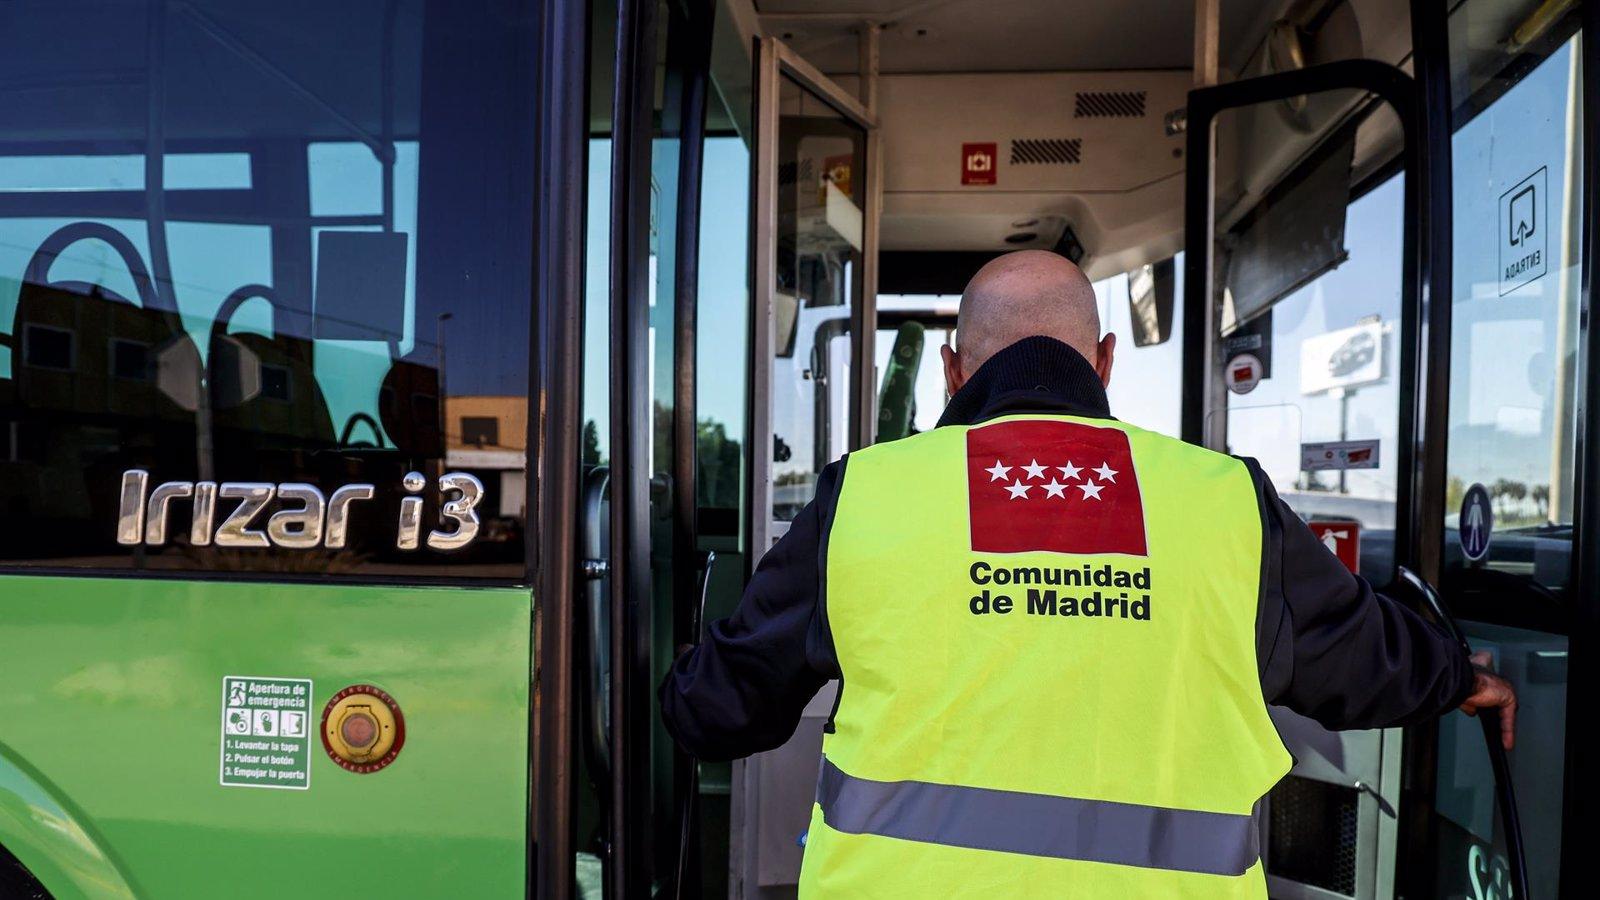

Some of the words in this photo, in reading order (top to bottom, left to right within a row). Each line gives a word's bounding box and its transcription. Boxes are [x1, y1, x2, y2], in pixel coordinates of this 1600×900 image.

[117, 469, 375, 549] Irizar
[397, 471, 484, 550] i3
[969, 561, 1151, 590] Comunidad
[969, 590, 1014, 615] de
[1027, 588, 1151, 621] Madrid
[248, 682, 290, 694] Apertura
[293, 685, 305, 695] de
[248, 695, 305, 708] emergencia
[327, 686, 398, 710] EMERGENCIA
[226, 741, 234, 749] 1.
[235, 741, 270, 750] Levantar
[271, 742, 279, 750] la
[280, 743, 299, 752] tapa
[225, 754, 233, 762] 2.
[234, 754, 260, 763] Pulsar
[261, 755, 269, 764] el
[270, 756, 294, 765] botón
[328, 751, 398, 773] EMERGENCIA
[225, 767, 233, 776] 3.
[234, 767, 267, 779] Empujar
[269, 769, 277, 778] la
[278, 770, 305, 780] puerta
